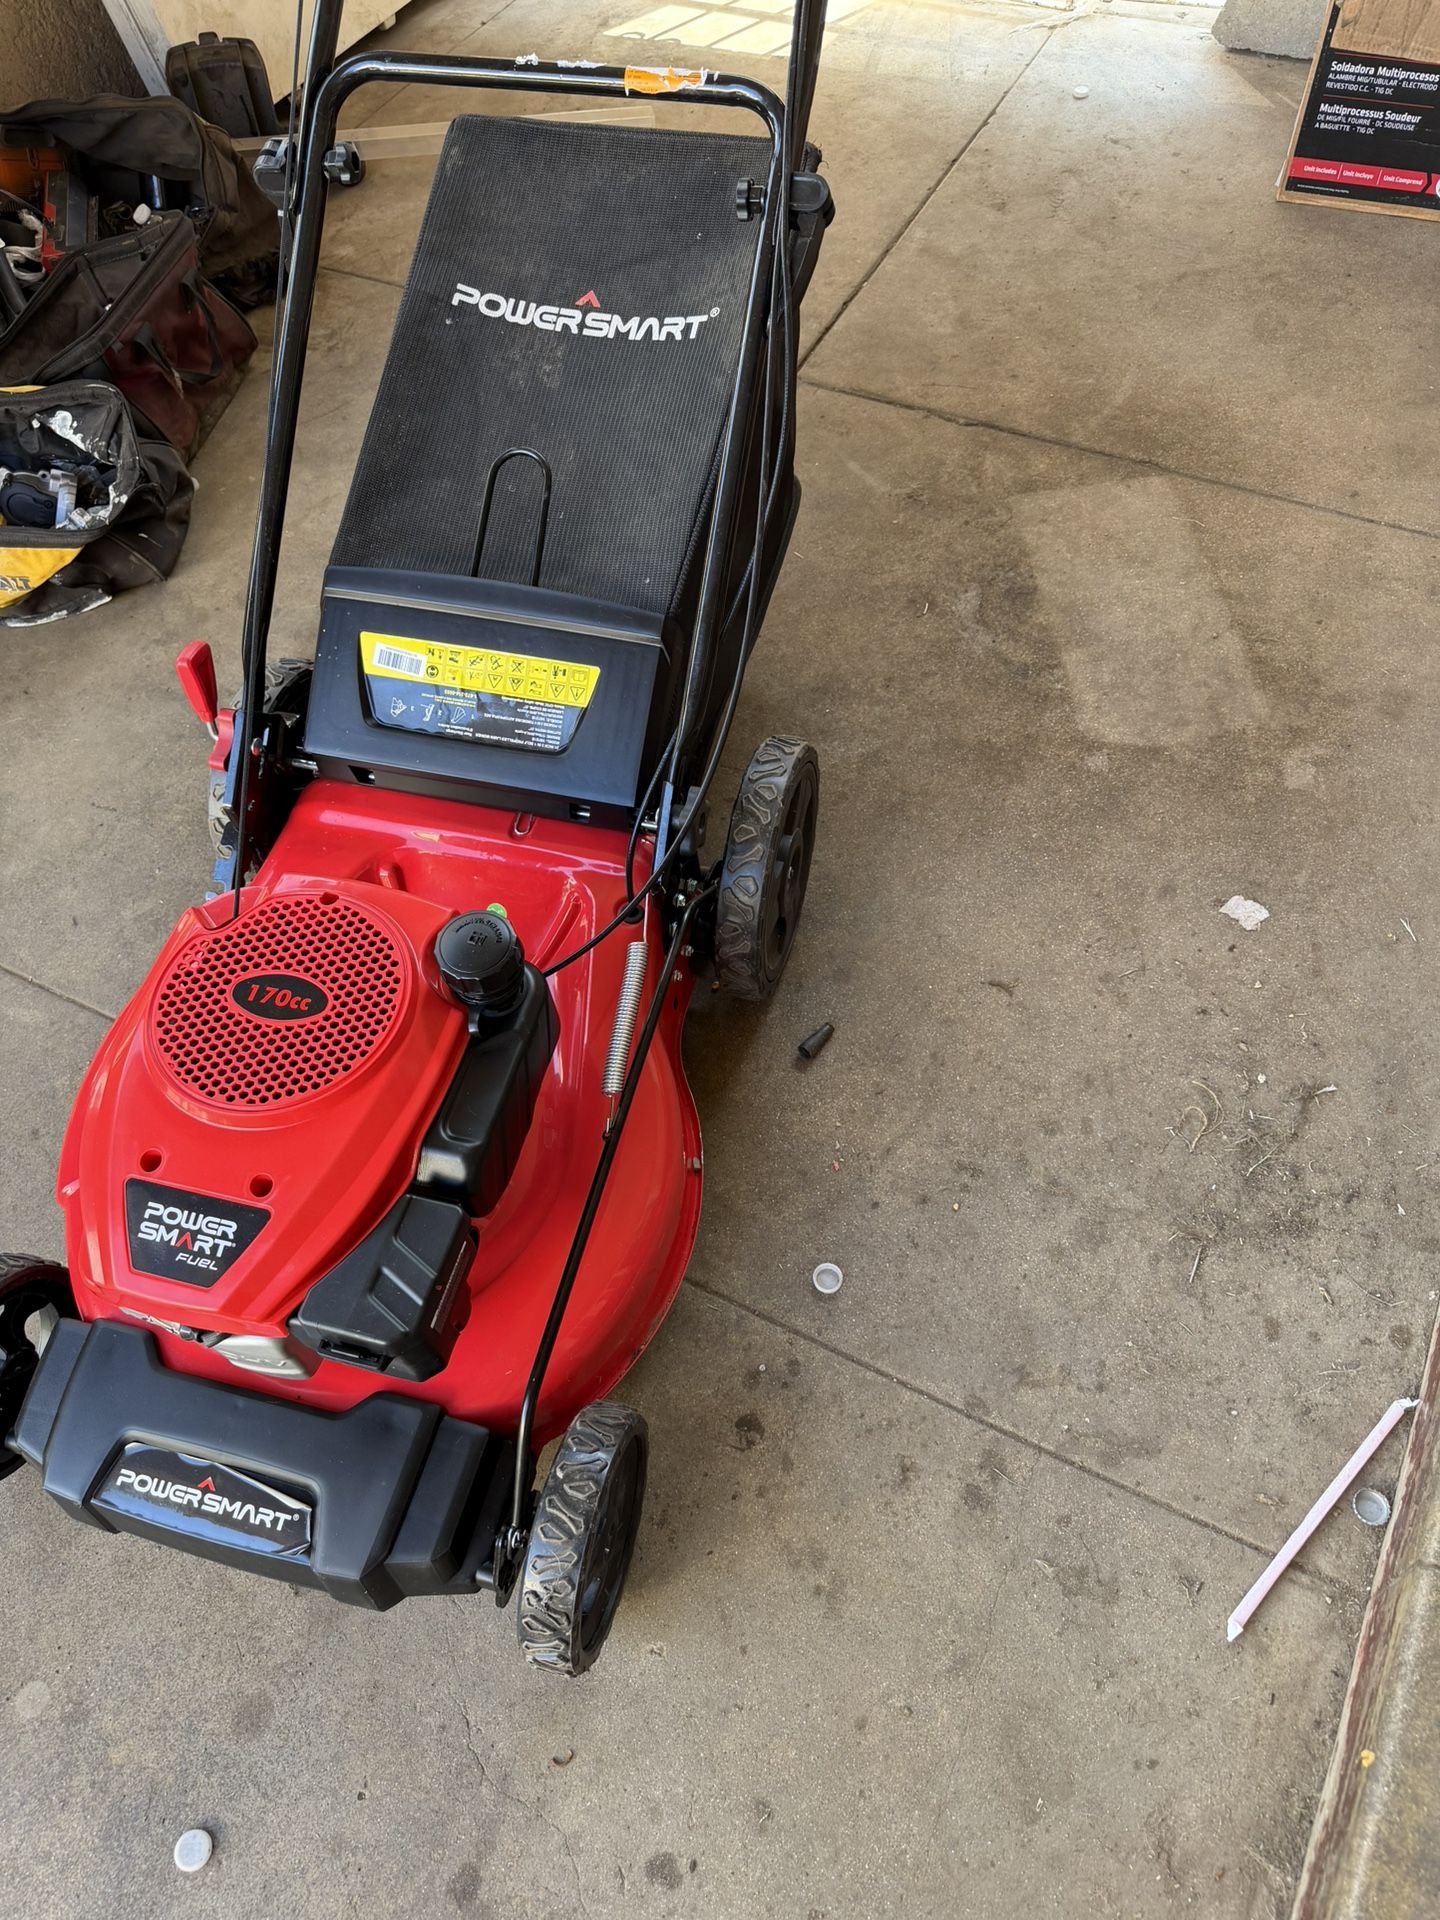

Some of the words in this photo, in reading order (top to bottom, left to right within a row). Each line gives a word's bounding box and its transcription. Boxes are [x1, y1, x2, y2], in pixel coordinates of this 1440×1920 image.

[1328, 72, 1357, 82] ALAMBRE
[1357, 75, 1398, 87] MIG/TUBULAR
[1402, 80, 1438, 91] ELECTRODO
[1331, 61, 1375, 75] Soldadora
[1377, 66, 1440, 83] Multiprocesos
[1326, 81, 1358, 92] REVESTIDO
[1375, 86, 1385, 94] TIG
[1317, 113, 1326, 121] DE
[1376, 120, 1384, 128] DC
[1384, 121, 1415, 131] SOUDEUSE
[1320, 103, 1384, 119] Multiprocessus
[1385, 110, 1422, 123] Soudeur
[1321, 122, 1351, 132] BAGUETTE
[1357, 126, 1366, 134] TIG
[1367, 127, 1376, 135] DC
[247, 984, 312, 1011] 170cc
[143, 1201, 238, 1240] POWER
[175, 1252, 218, 1271] FUEL
